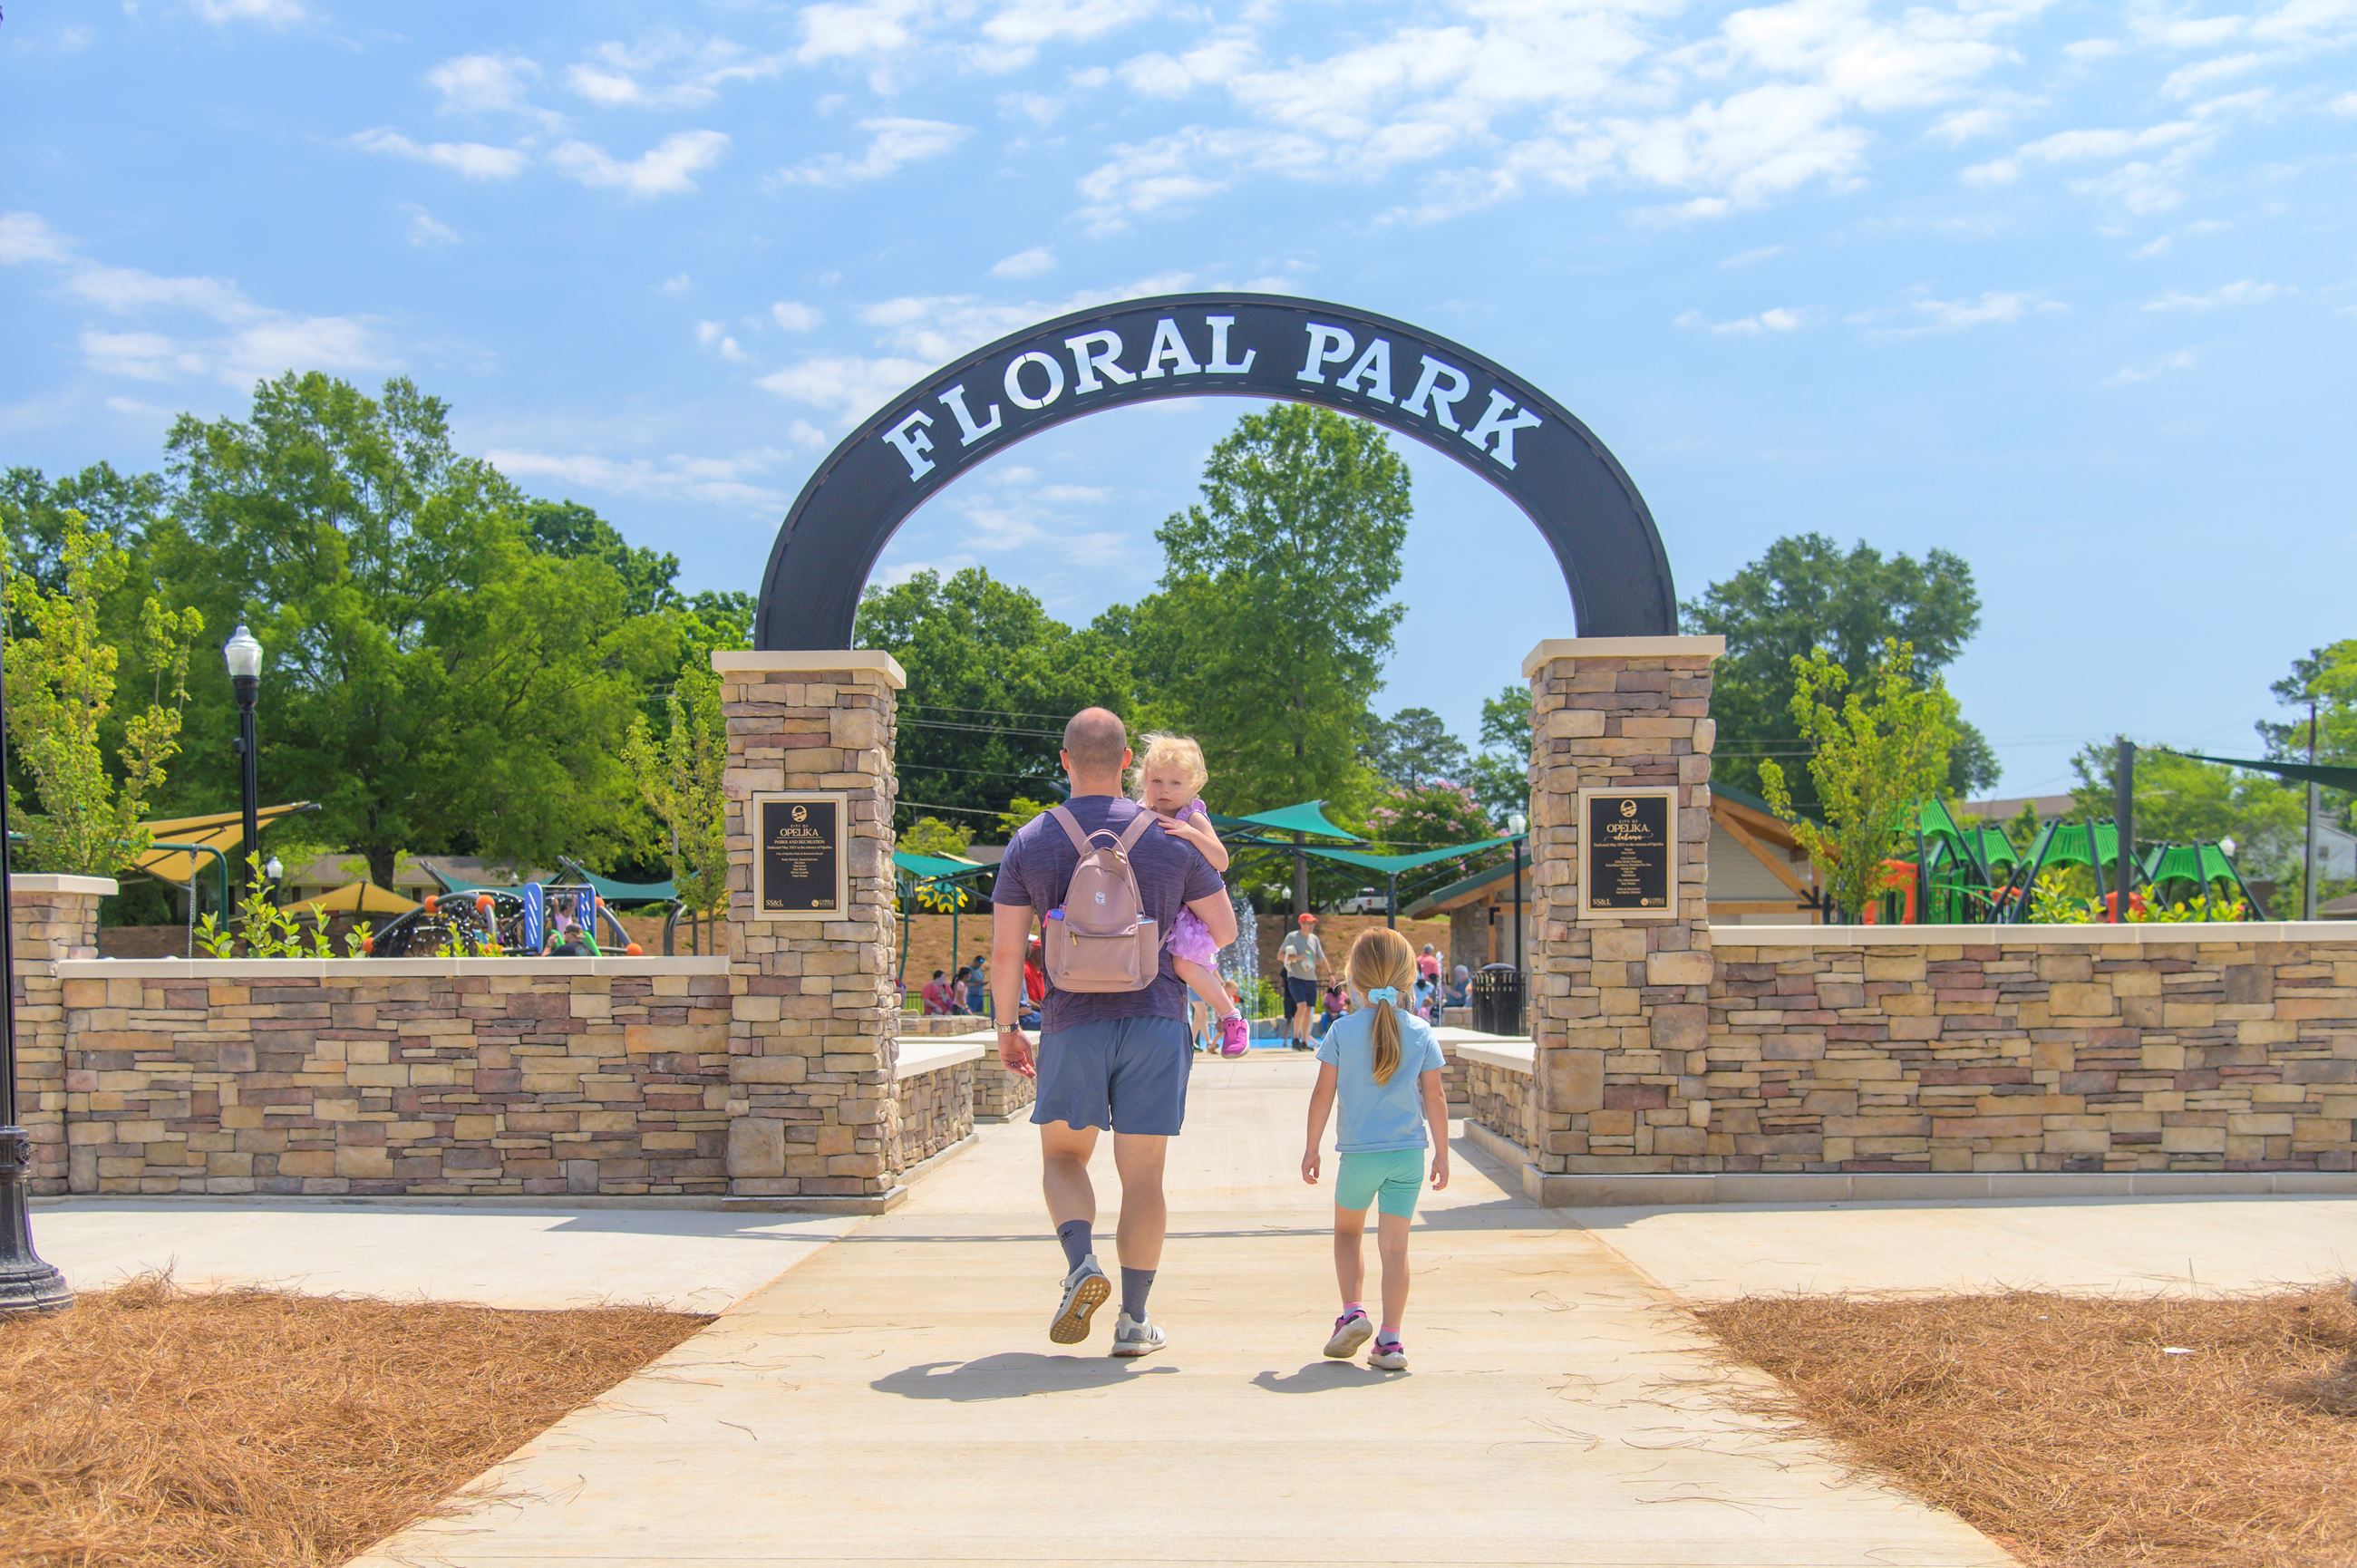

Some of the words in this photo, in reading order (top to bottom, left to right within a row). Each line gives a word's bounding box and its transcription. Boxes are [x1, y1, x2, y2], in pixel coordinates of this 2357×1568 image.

[881, 315, 1257, 483] FLORAL
[1296, 322, 1543, 470] PARK
[780, 828, 819, 837] OPELIKA
[1606, 823, 1648, 833] OPELIKA
